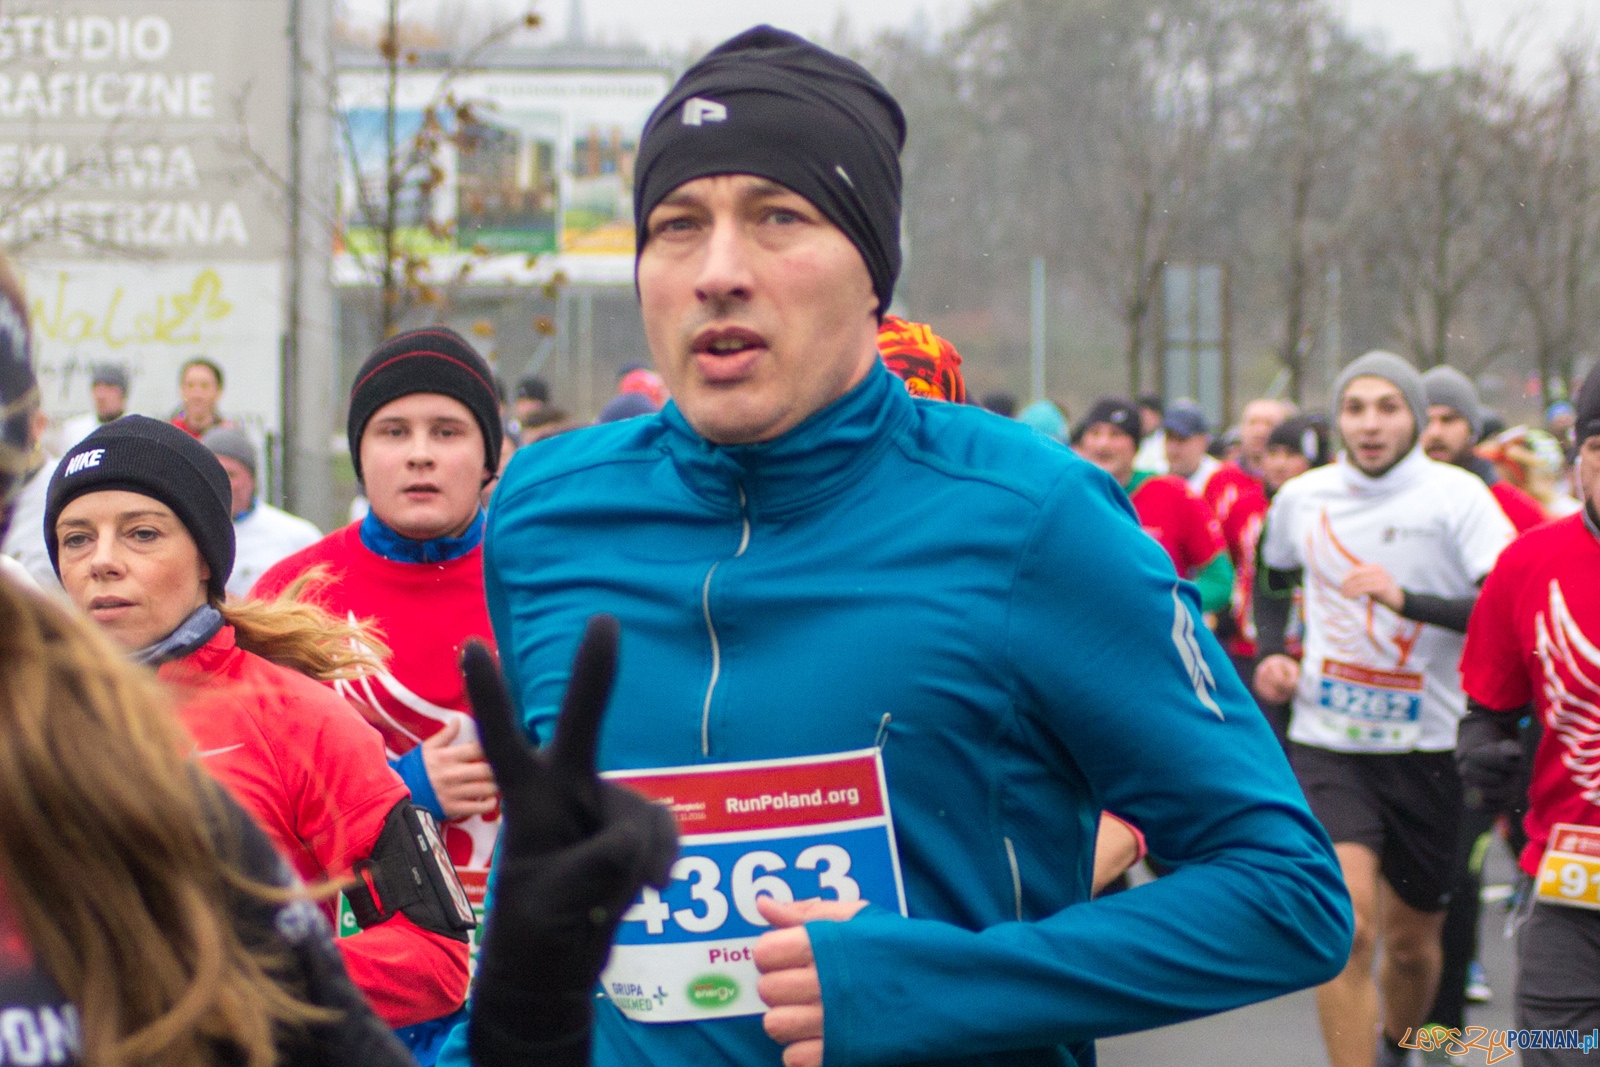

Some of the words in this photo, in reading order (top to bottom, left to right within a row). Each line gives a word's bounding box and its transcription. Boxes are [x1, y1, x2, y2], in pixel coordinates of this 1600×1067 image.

[65, 449, 105, 477] NIKE
[726, 788, 859, 813] RunPoland.org
[622, 845, 861, 934] 4363
[709, 947, 752, 964] Piot
[612, 982, 643, 997] GRUPA
